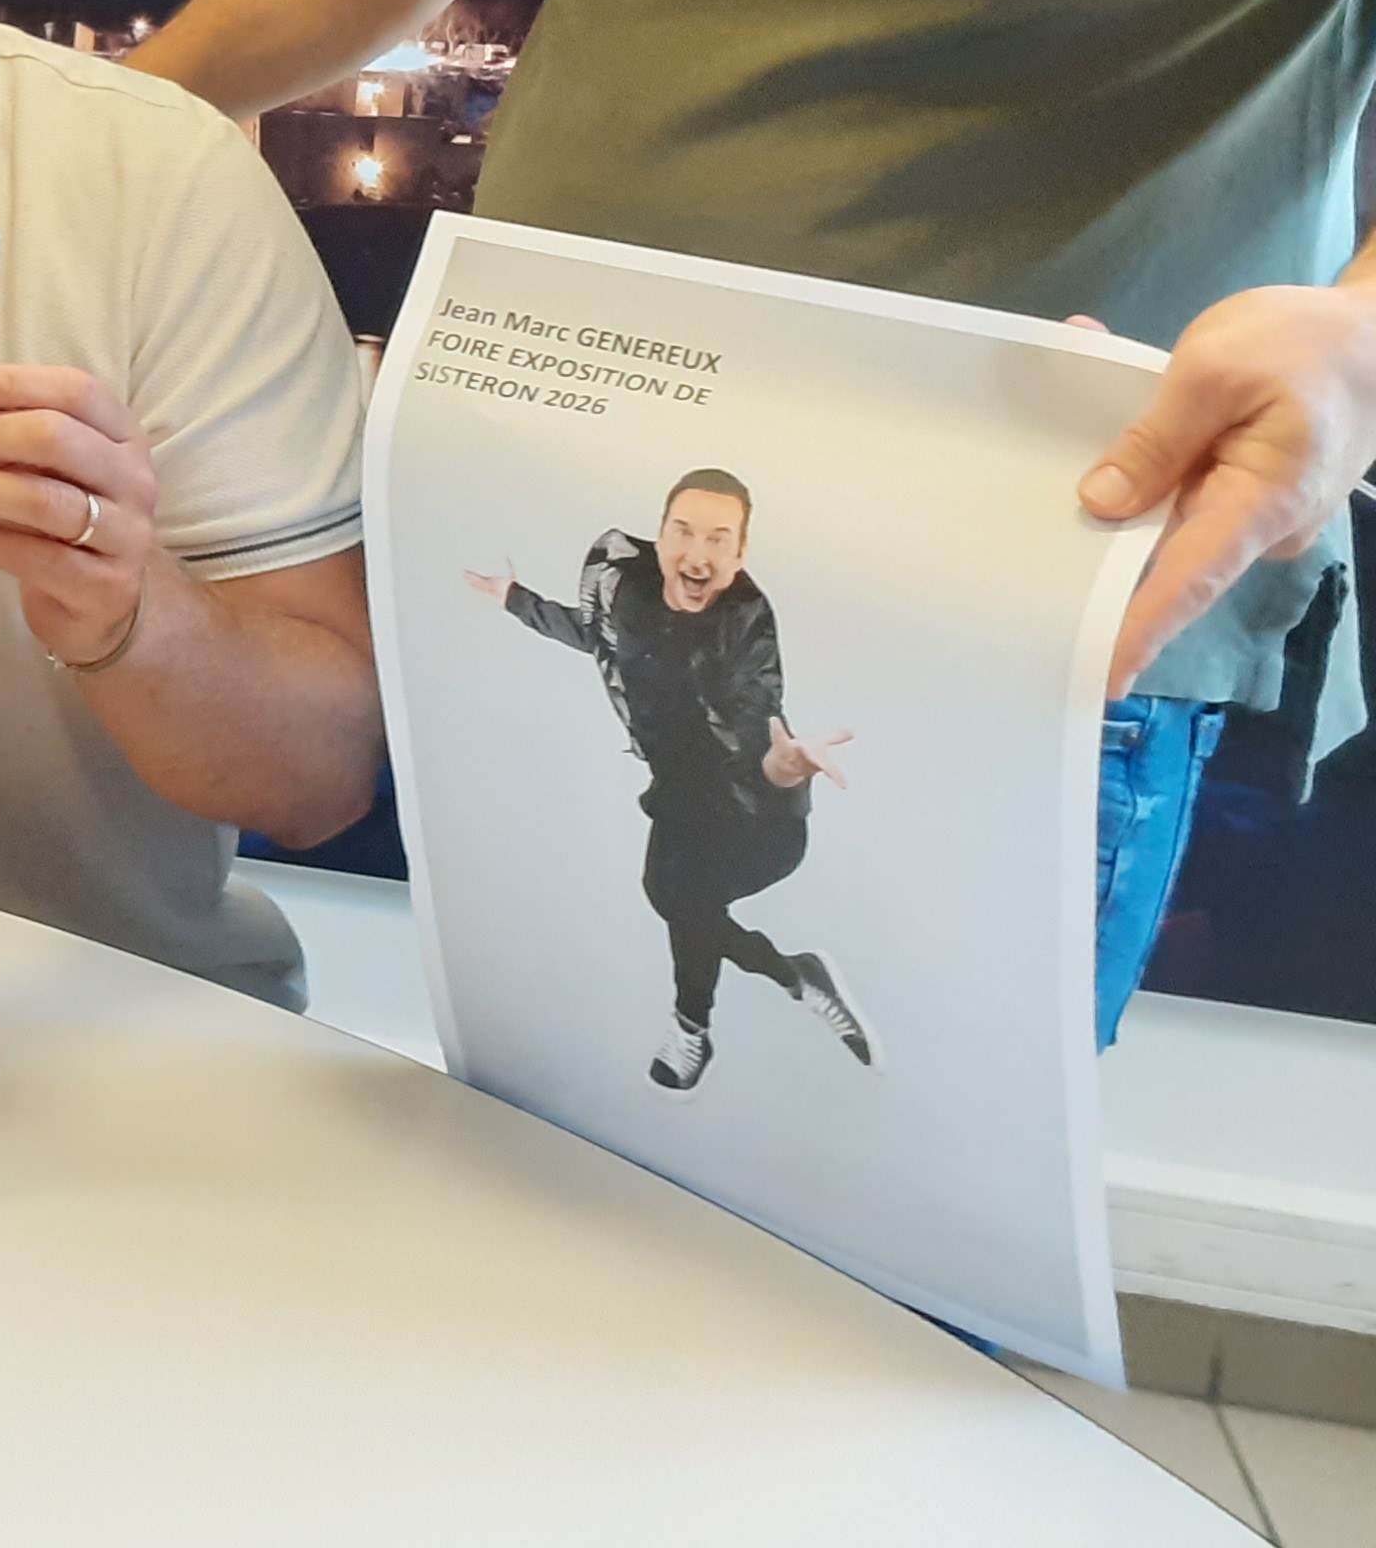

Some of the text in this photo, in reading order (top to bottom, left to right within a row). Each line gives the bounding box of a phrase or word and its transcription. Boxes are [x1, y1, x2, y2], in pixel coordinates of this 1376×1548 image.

[427, 330, 712, 406] FOIRE EXPOSITION DE
[439, 298, 722, 374] Jean Marc GENEREUX
[414, 361, 609, 415] SISTERON 2026
